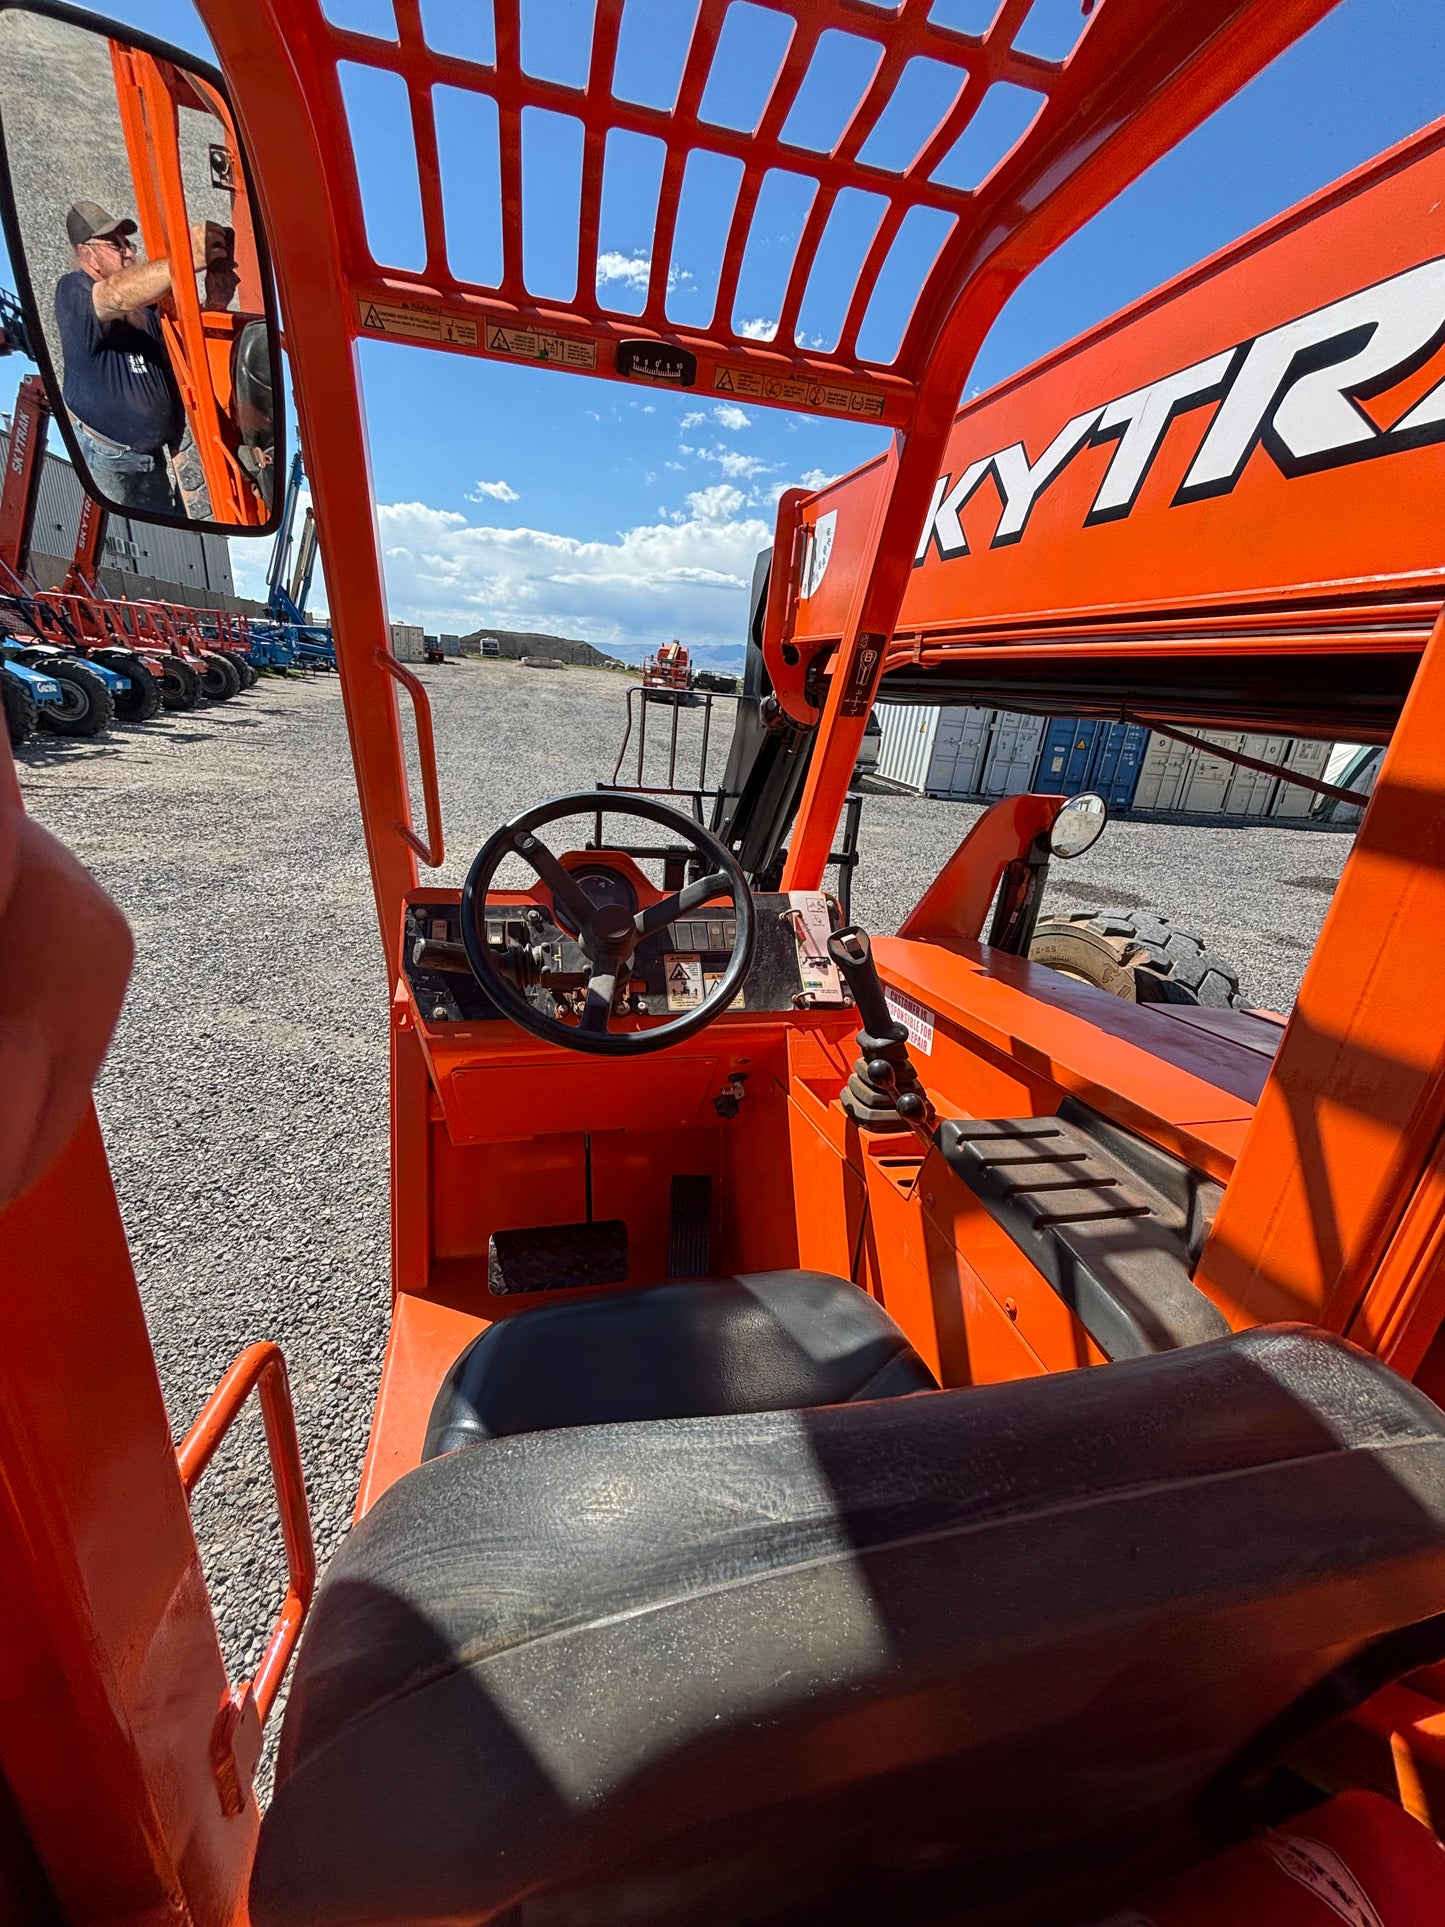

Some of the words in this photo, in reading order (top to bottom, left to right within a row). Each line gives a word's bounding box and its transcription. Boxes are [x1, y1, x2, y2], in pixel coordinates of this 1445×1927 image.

[913, 254, 1445, 568] KYTR
[12, 408, 30, 475] SKYTRAK
[887, 1001, 920, 1033] ESPONSIBLE
[920, 1021, 932, 1041] FOR
[890, 990, 920, 1016] CUSTOMER
